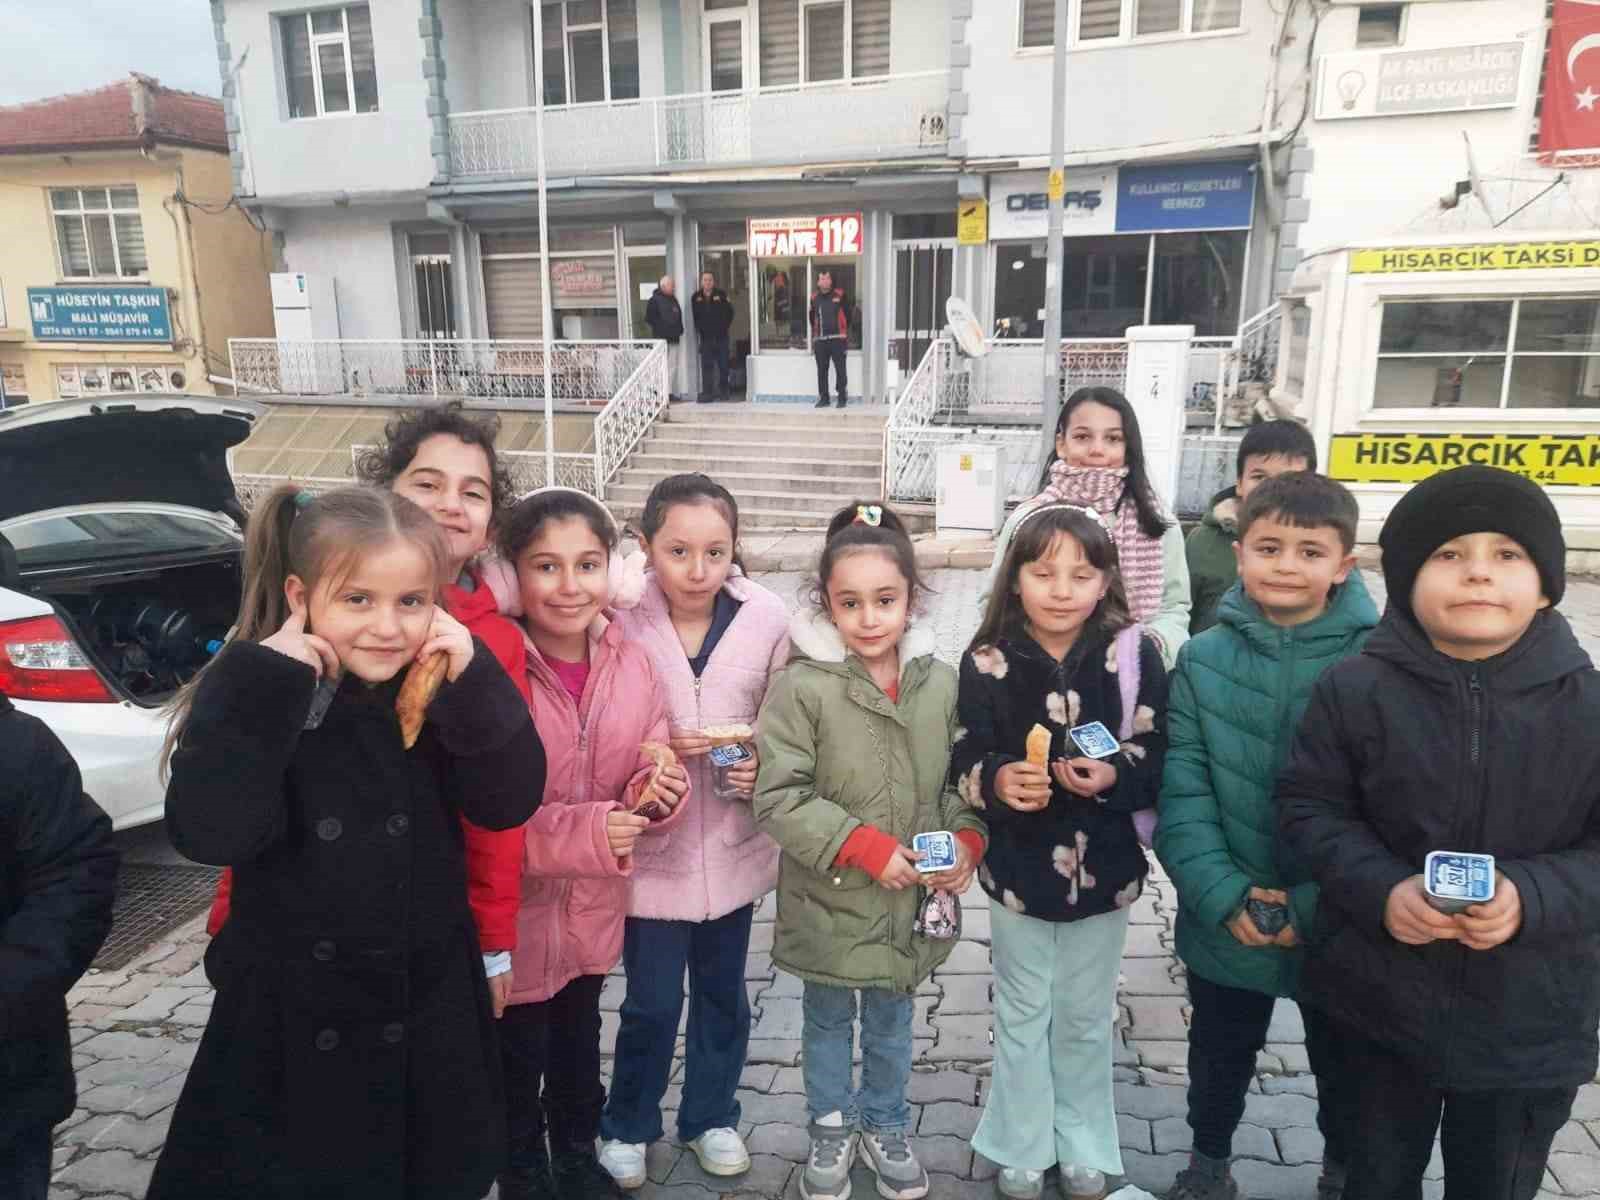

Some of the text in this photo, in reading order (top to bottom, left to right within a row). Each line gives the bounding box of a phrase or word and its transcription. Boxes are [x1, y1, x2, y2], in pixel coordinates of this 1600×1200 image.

[818, 216, 860, 254] 112
[56, 293, 111, 307] HÜSEYİN
[71, 311, 149, 325] MALİ MÜŞAVİR
